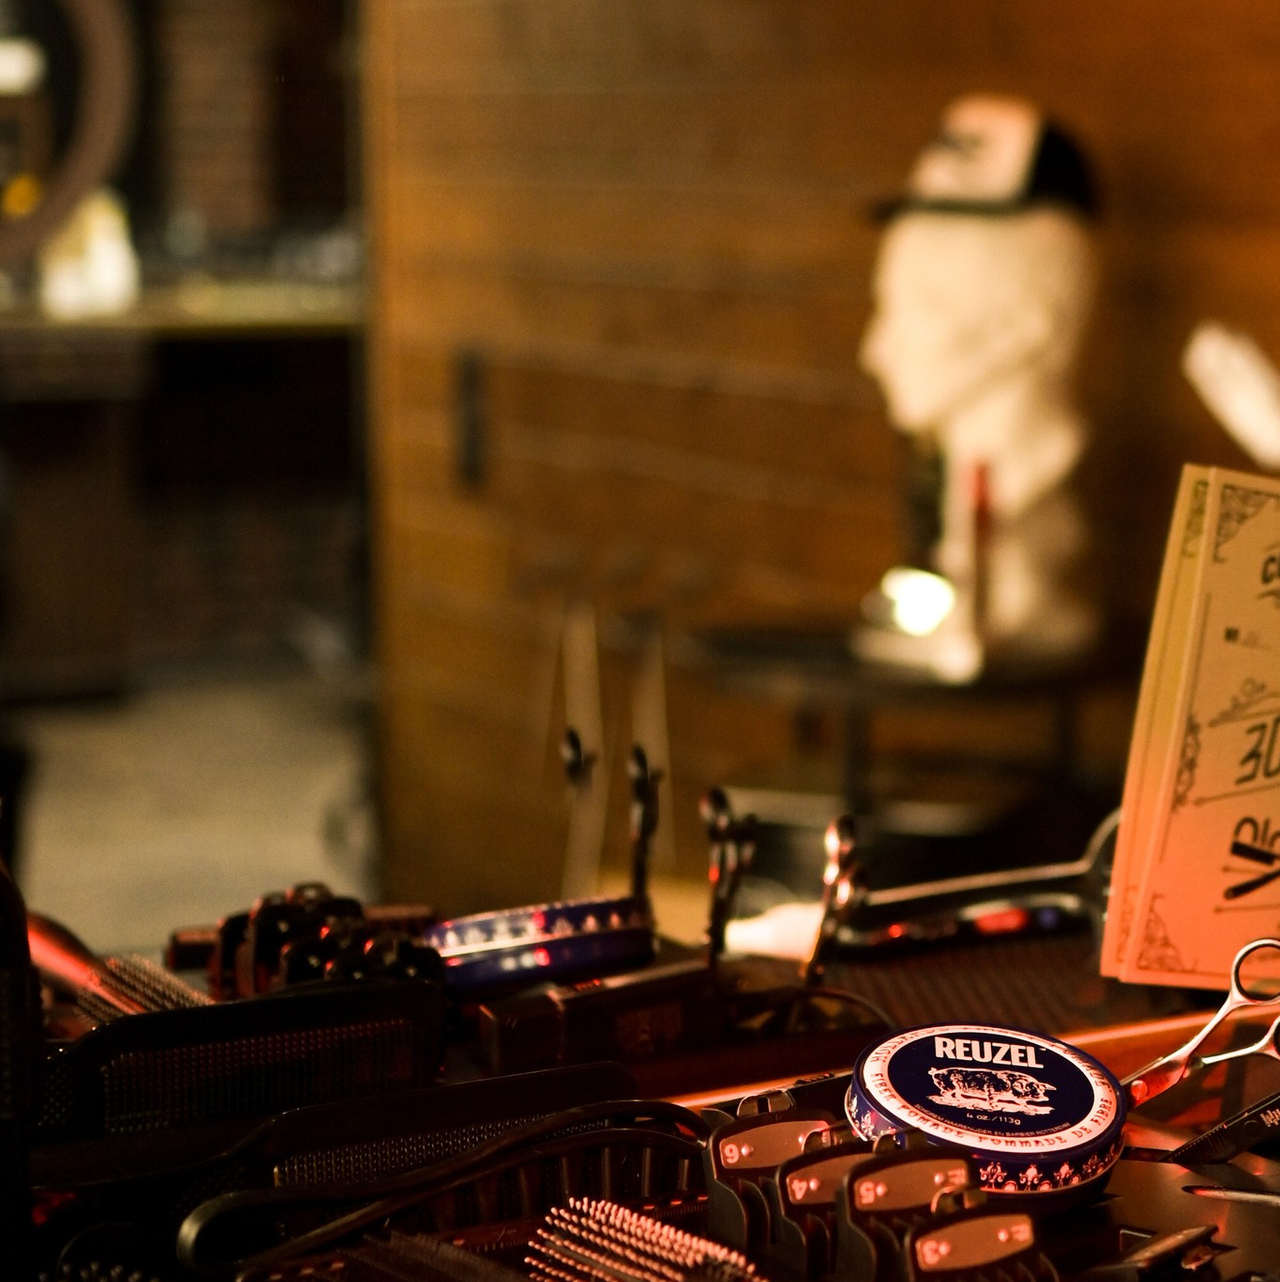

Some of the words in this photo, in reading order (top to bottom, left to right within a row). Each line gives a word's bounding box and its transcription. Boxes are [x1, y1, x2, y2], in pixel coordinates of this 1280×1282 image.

[934, 1035, 1044, 1069] REUZEL
[977, 1135, 1067, 1148] POMMADE
[1071, 1126, 1092, 1138] DE
[1090, 1098, 1113, 1125] FIBRE
